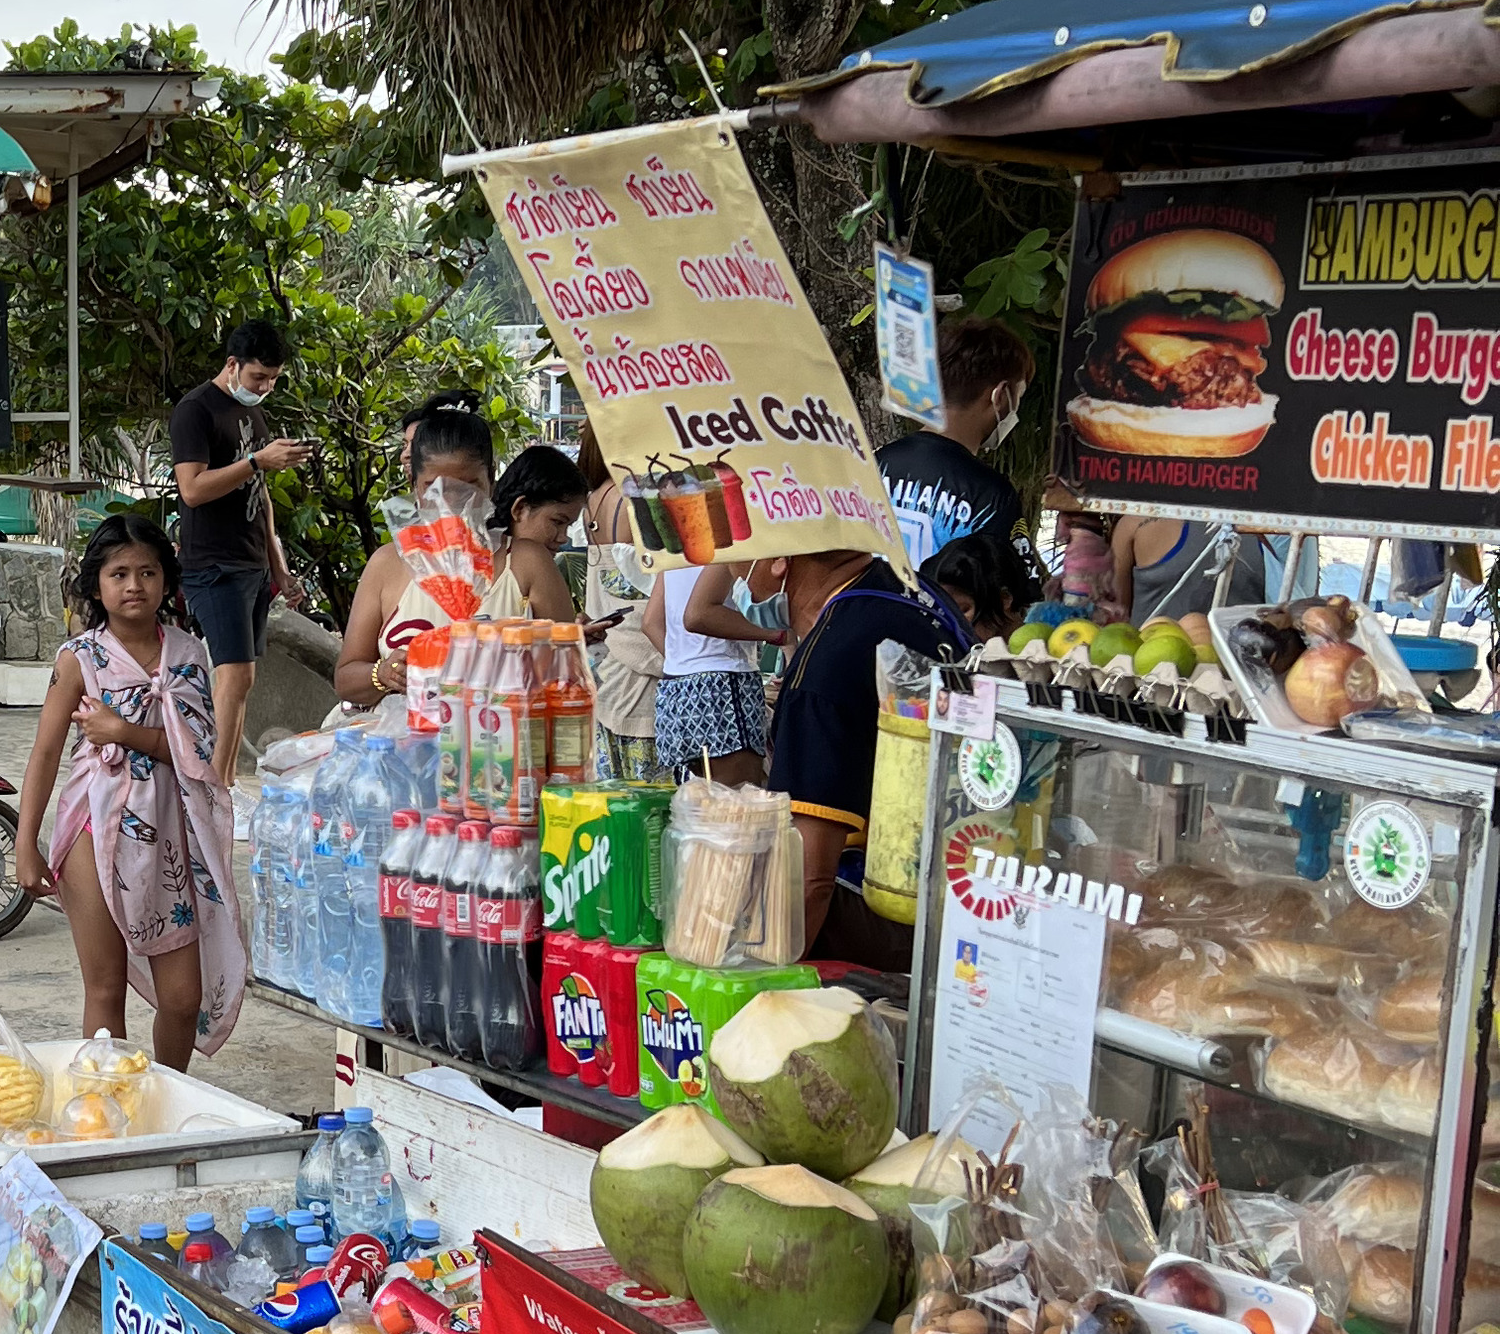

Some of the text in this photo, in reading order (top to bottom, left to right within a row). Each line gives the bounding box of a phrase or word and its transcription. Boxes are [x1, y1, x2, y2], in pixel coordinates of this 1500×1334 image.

[506, 156, 713, 240] ชาดำเย็น ชาเย็น
[526, 237, 650, 320] โอเลี้ยง
[573, 327, 731, 398] น้ำอ้อยสด
[1288, 308, 1399, 382] Cheese
[666, 396, 866, 460] Iced Coffee
[1312, 410, 1432, 489] Chicken
[1079, 455, 1259, 492] TING HAMBURGER
[542, 835, 612, 926] Sprite
[972, 847, 1143, 925] TARAMI
[552, 994, 607, 1036] FANTA
